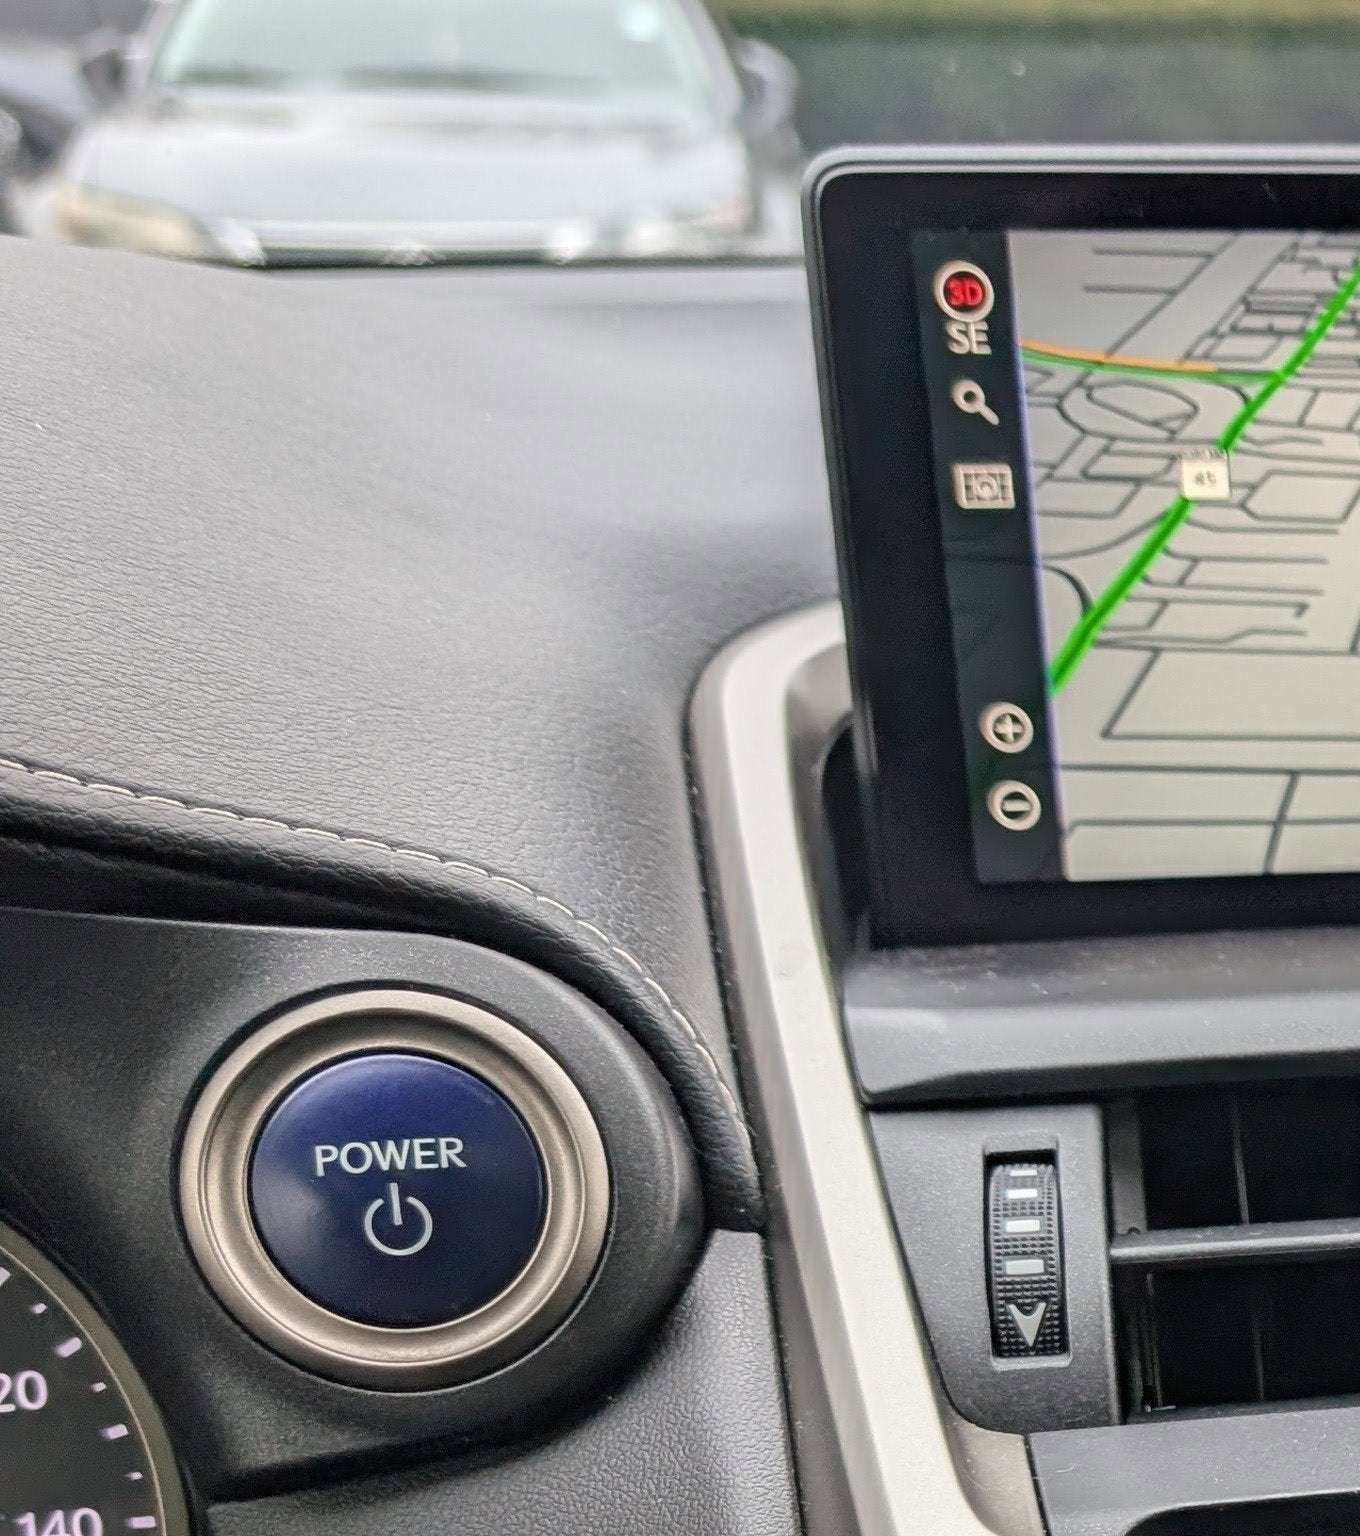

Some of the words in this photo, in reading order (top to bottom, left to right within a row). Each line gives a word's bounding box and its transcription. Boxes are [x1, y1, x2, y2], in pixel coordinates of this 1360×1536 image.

[945, 320, 992, 355] SE
[314, 1137, 468, 1177] POWER
[0, 1370, 49, 1412] 20
